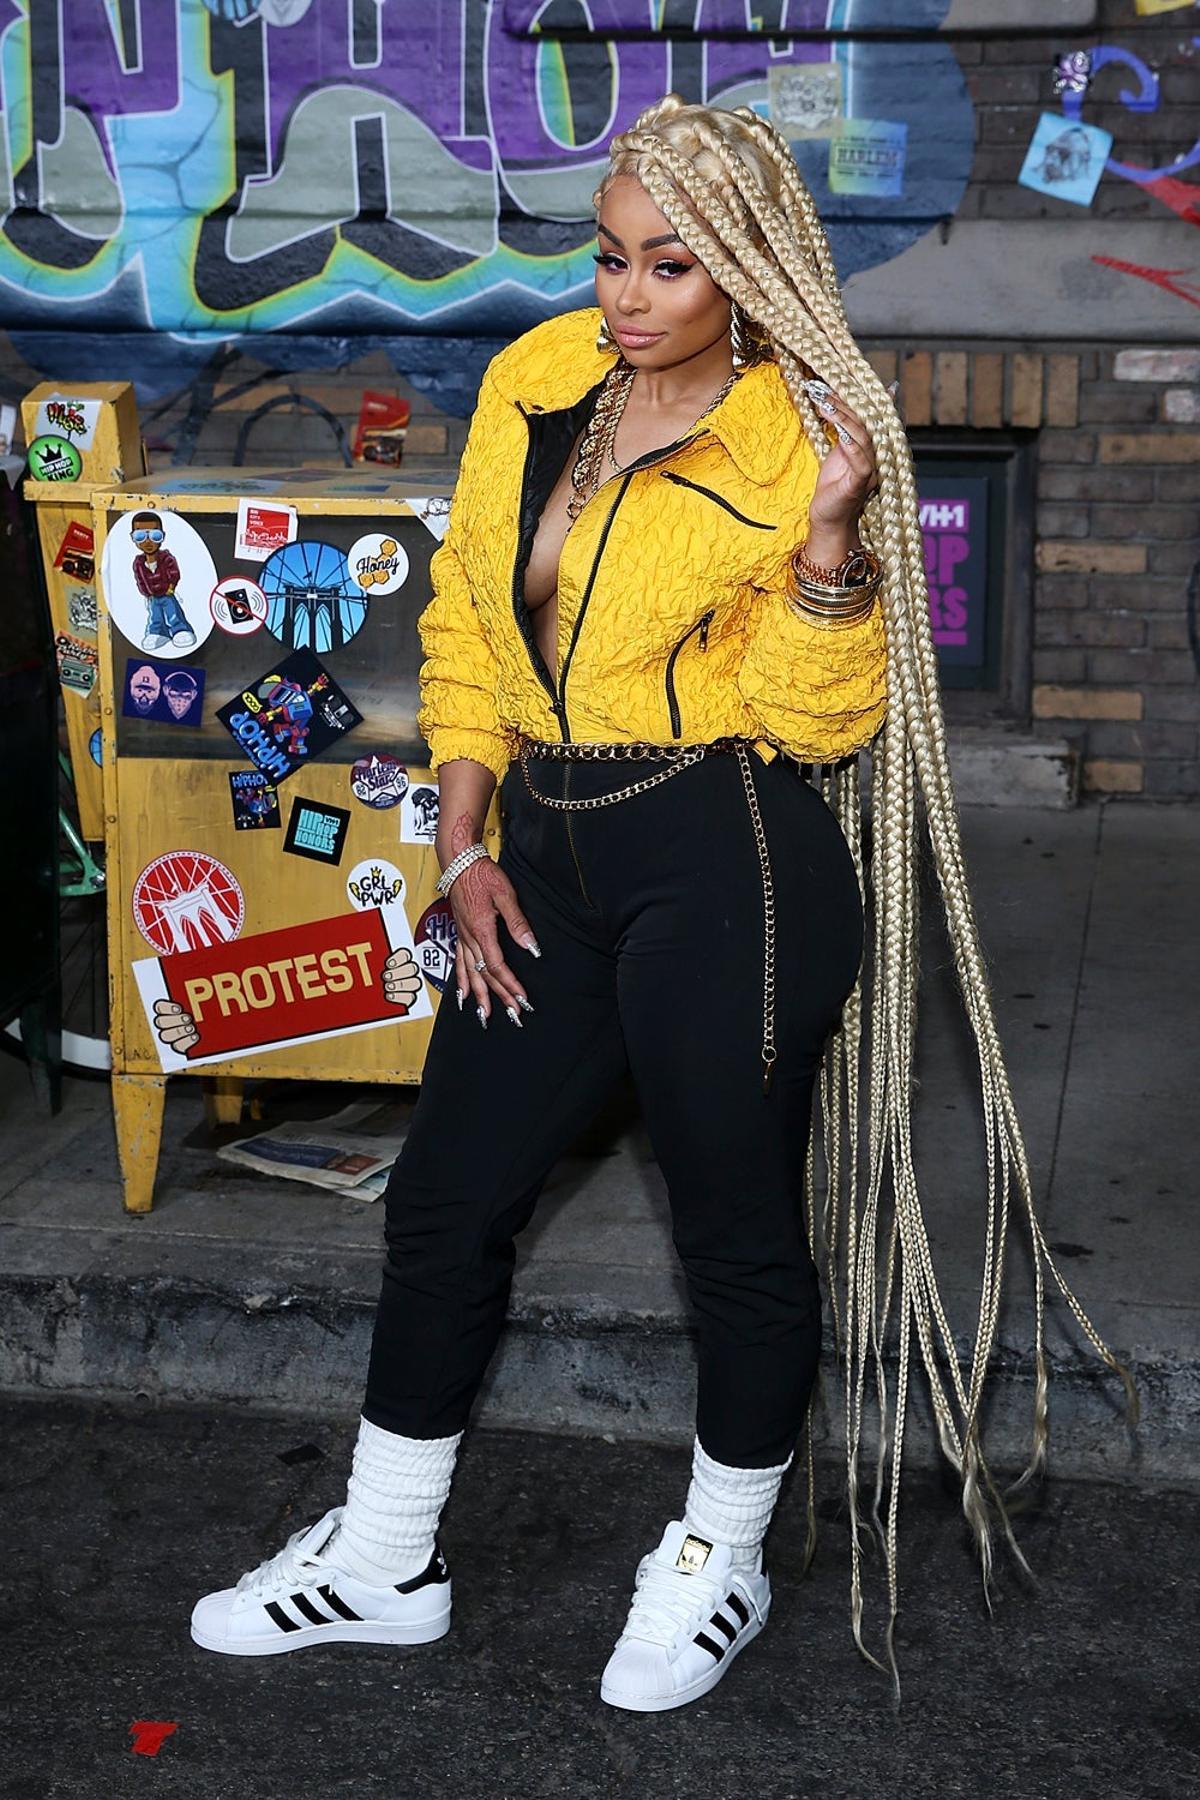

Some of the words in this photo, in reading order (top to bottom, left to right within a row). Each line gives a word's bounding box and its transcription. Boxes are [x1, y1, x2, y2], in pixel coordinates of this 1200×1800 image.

[837, 148, 897, 166] HARLEM
[42, 463, 55, 474] HIP
[55, 458, 73, 469] HOP
[47, 468, 74, 481] KING
[356, 555, 400, 575] Honey
[354, 761, 398, 781] Harlem
[368, 774, 392, 791] Star
[299, 808, 324, 830] HIP
[316, 822, 339, 839] HOP
[294, 830, 336, 850] HONORS
[360, 875, 392, 891] GRL
[361, 891, 395, 907] PWR
[423, 949, 440, 967] 82
[184, 942, 373, 1022] PROTEST
